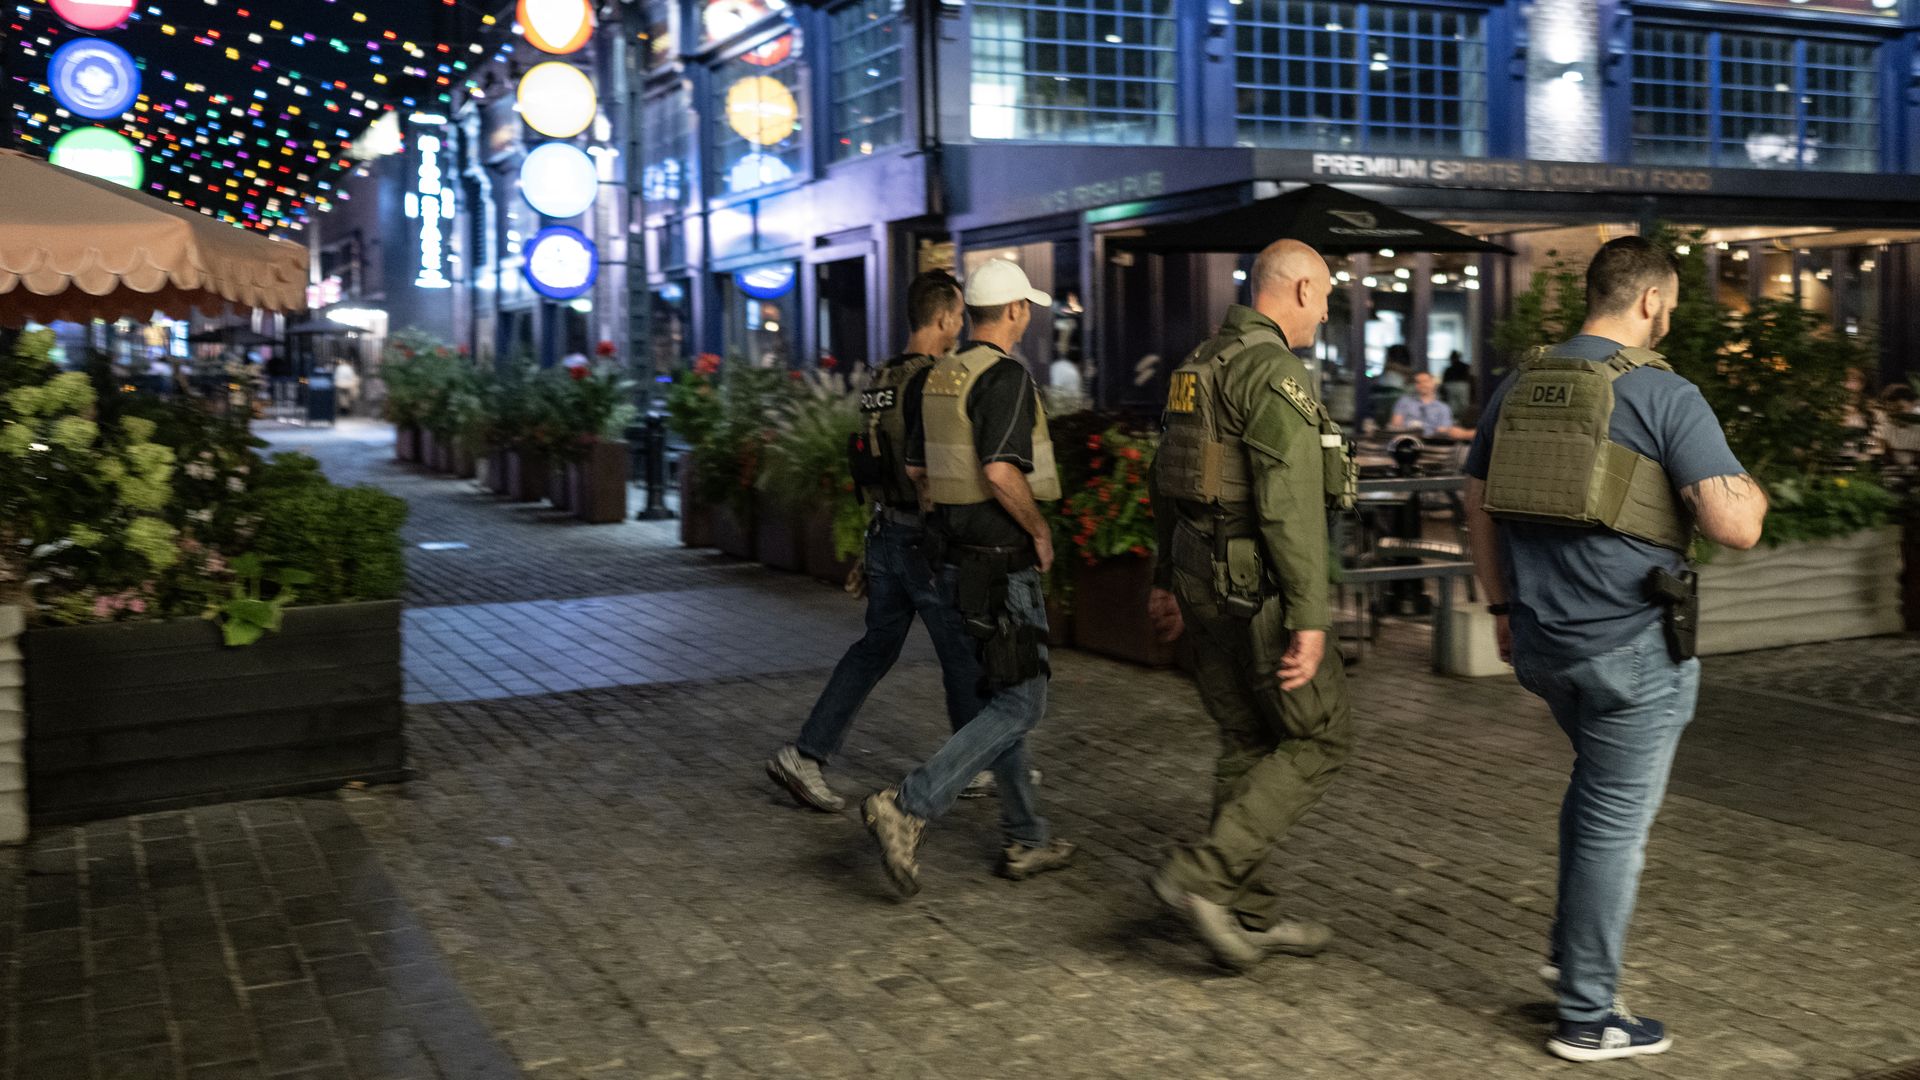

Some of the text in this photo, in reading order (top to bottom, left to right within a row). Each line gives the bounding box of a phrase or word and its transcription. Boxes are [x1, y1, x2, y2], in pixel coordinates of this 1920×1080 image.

[1313, 153, 1426, 178] PREMIUM
[1431, 159, 1521, 182] SPIRITS
[1549, 166, 1645, 190] QUALITY
[1650, 170, 1712, 195] FOOD
[1531, 385, 1566, 403] DEA
